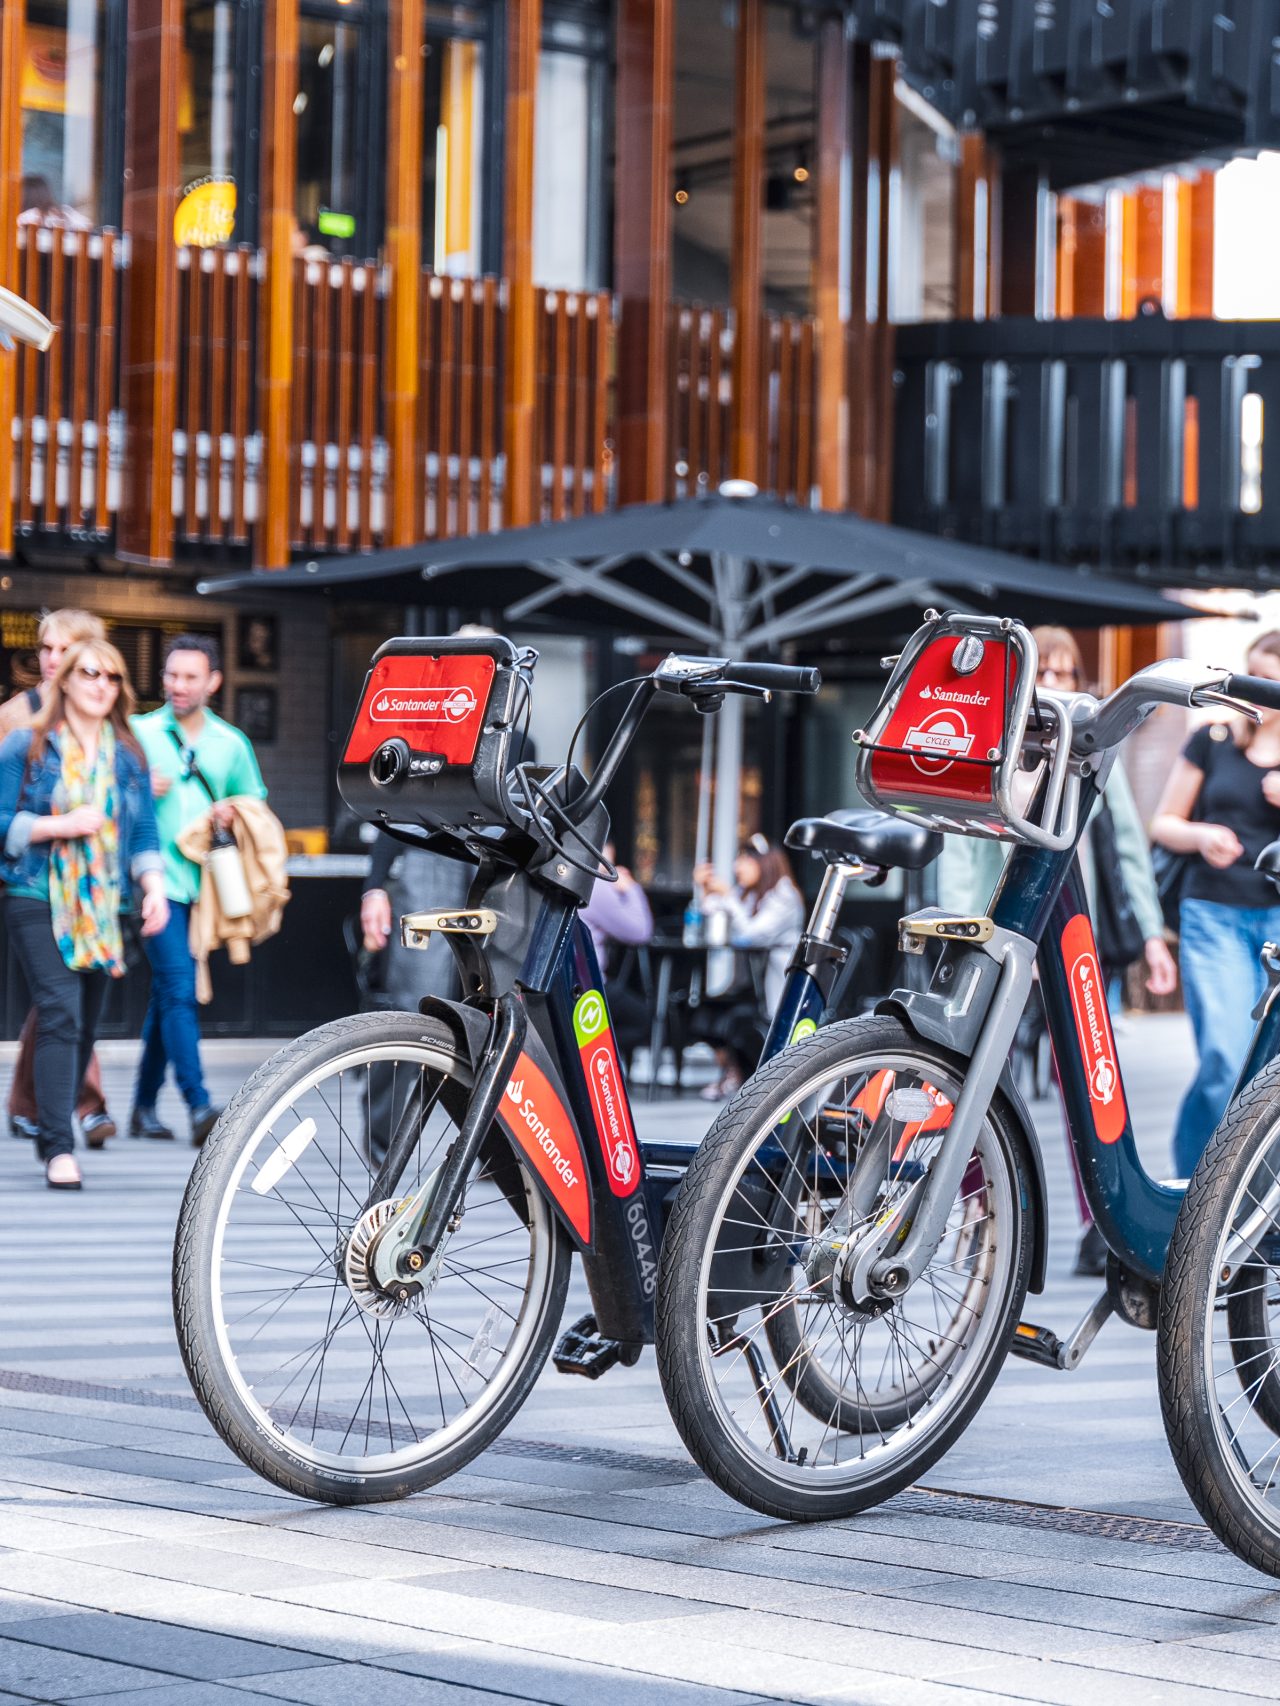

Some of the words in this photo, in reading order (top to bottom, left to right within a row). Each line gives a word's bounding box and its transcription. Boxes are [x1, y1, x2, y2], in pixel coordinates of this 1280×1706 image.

[390, 698, 440, 711] Santander
[932, 686, 990, 706] Santander
[925, 736, 951, 746] CYCLES
[1082, 979, 1102, 1054] Santander
[420, 1035, 457, 1053] SCHWAL
[600, 1073, 620, 1139] Santander
[518, 1098, 578, 1189] Santander
[627, 1203, 658, 1294] 60448
